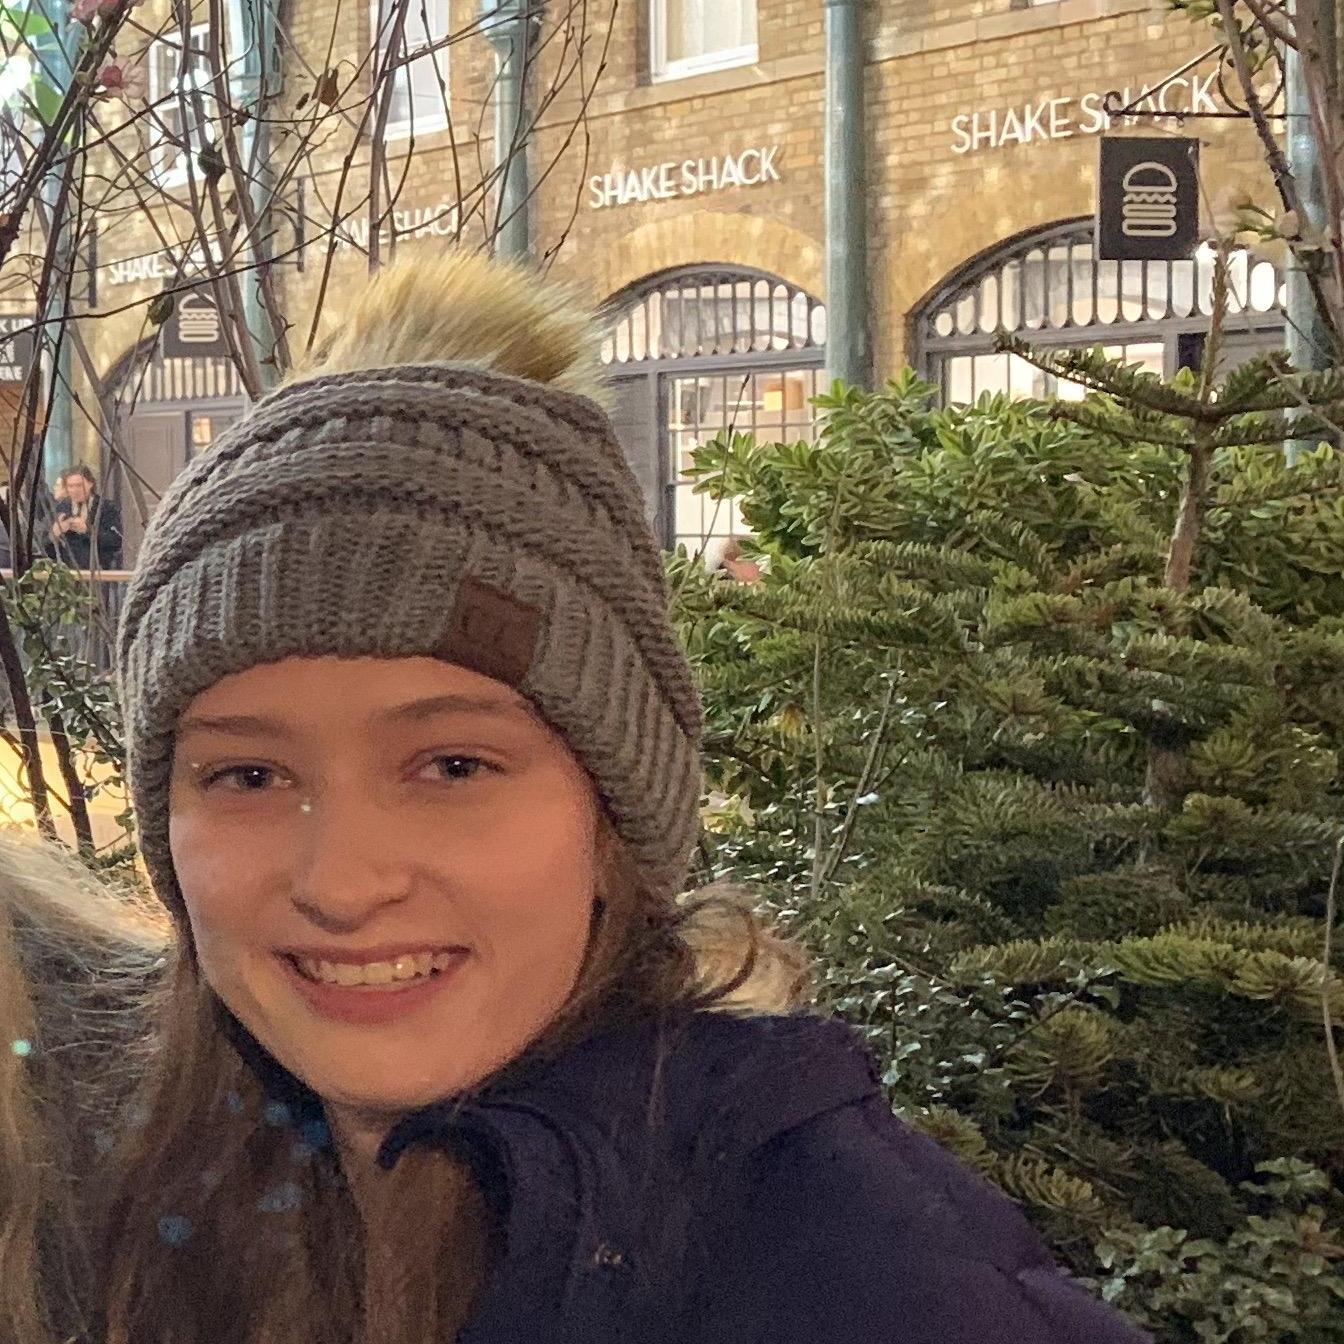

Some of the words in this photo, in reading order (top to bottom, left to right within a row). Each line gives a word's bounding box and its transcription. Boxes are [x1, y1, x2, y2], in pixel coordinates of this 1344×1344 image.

[950, 97, 1074, 154] SHAKE
[588, 162, 679, 209] SHAKE
[680, 145, 781, 196] SHACK
